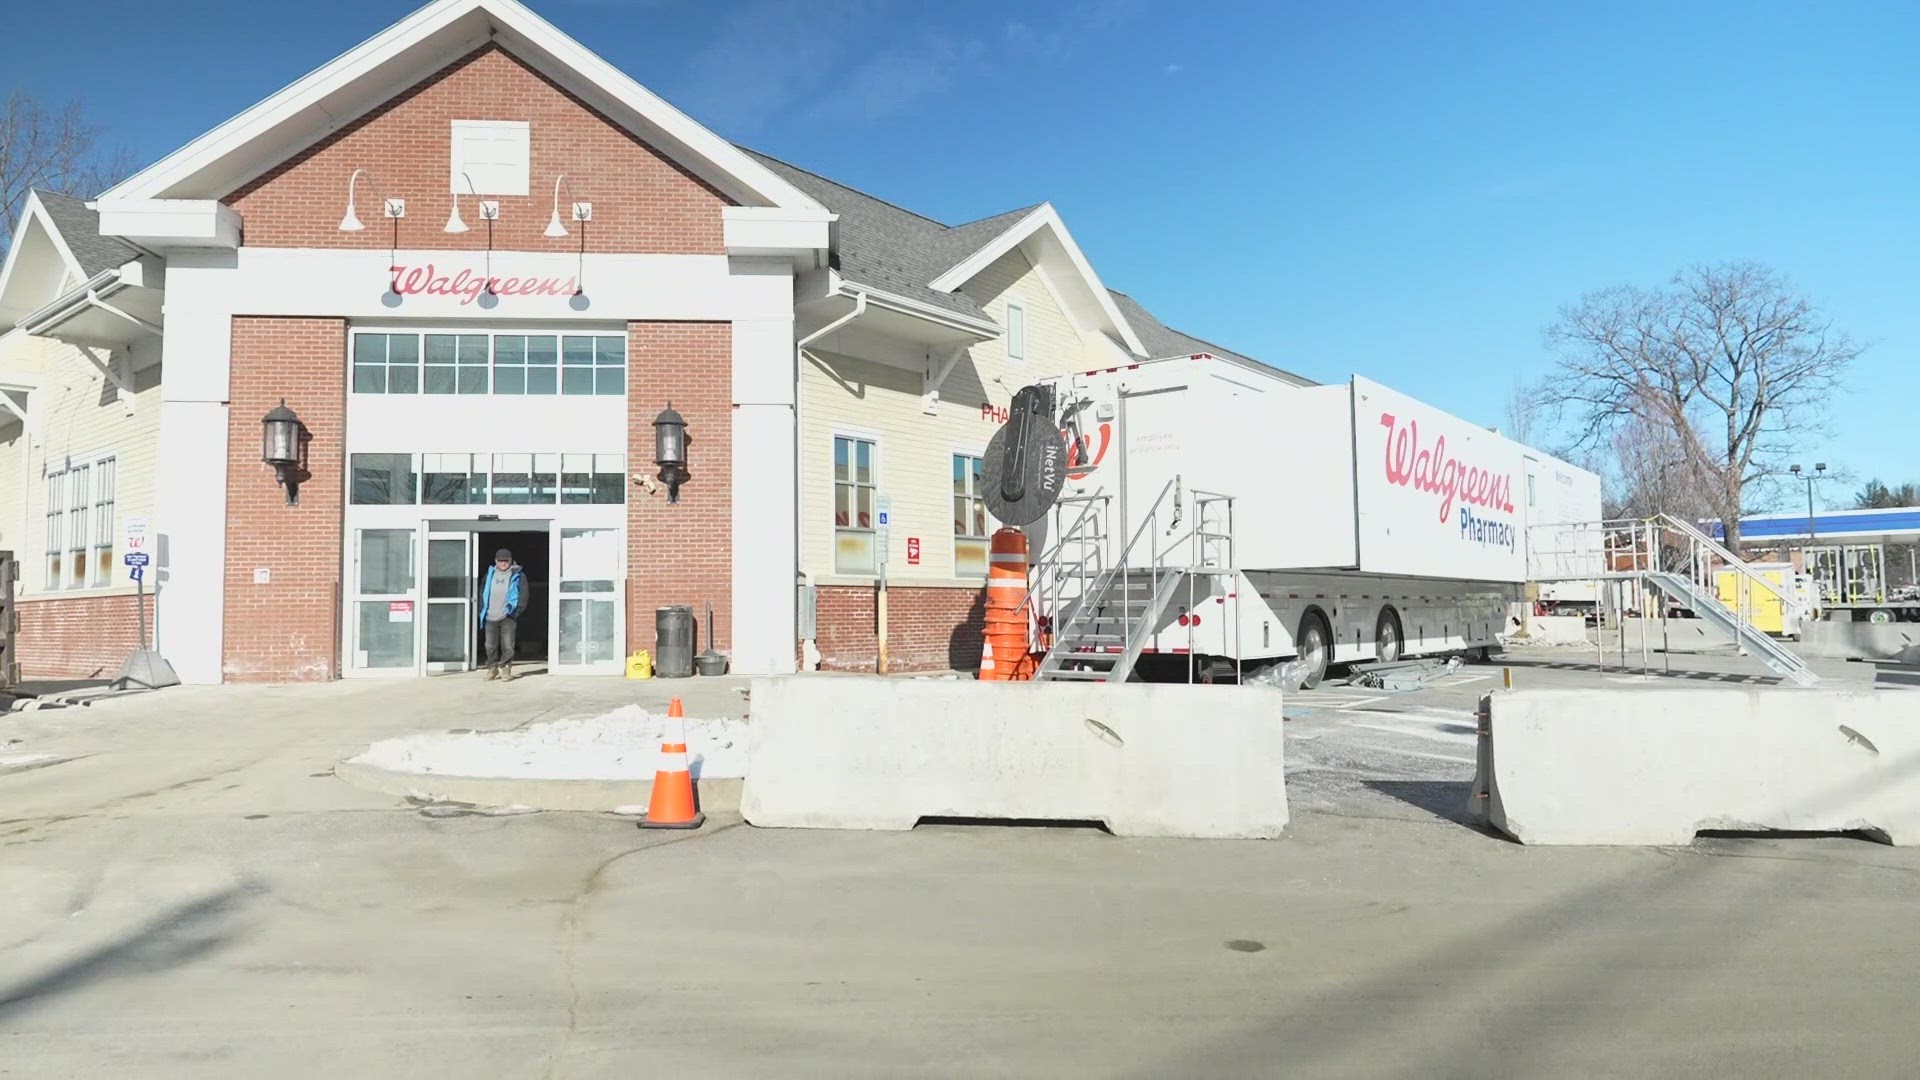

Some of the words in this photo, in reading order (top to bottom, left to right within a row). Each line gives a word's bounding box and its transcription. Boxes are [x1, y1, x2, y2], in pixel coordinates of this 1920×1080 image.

[389, 264, 582, 306] Walgreens
[981, 402, 1009, 424] PHA
[1043, 445, 1058, 491] iNetVu
[1380, 412, 1514, 524] Walgreens
[1460, 506, 1516, 556] Pharmacy
